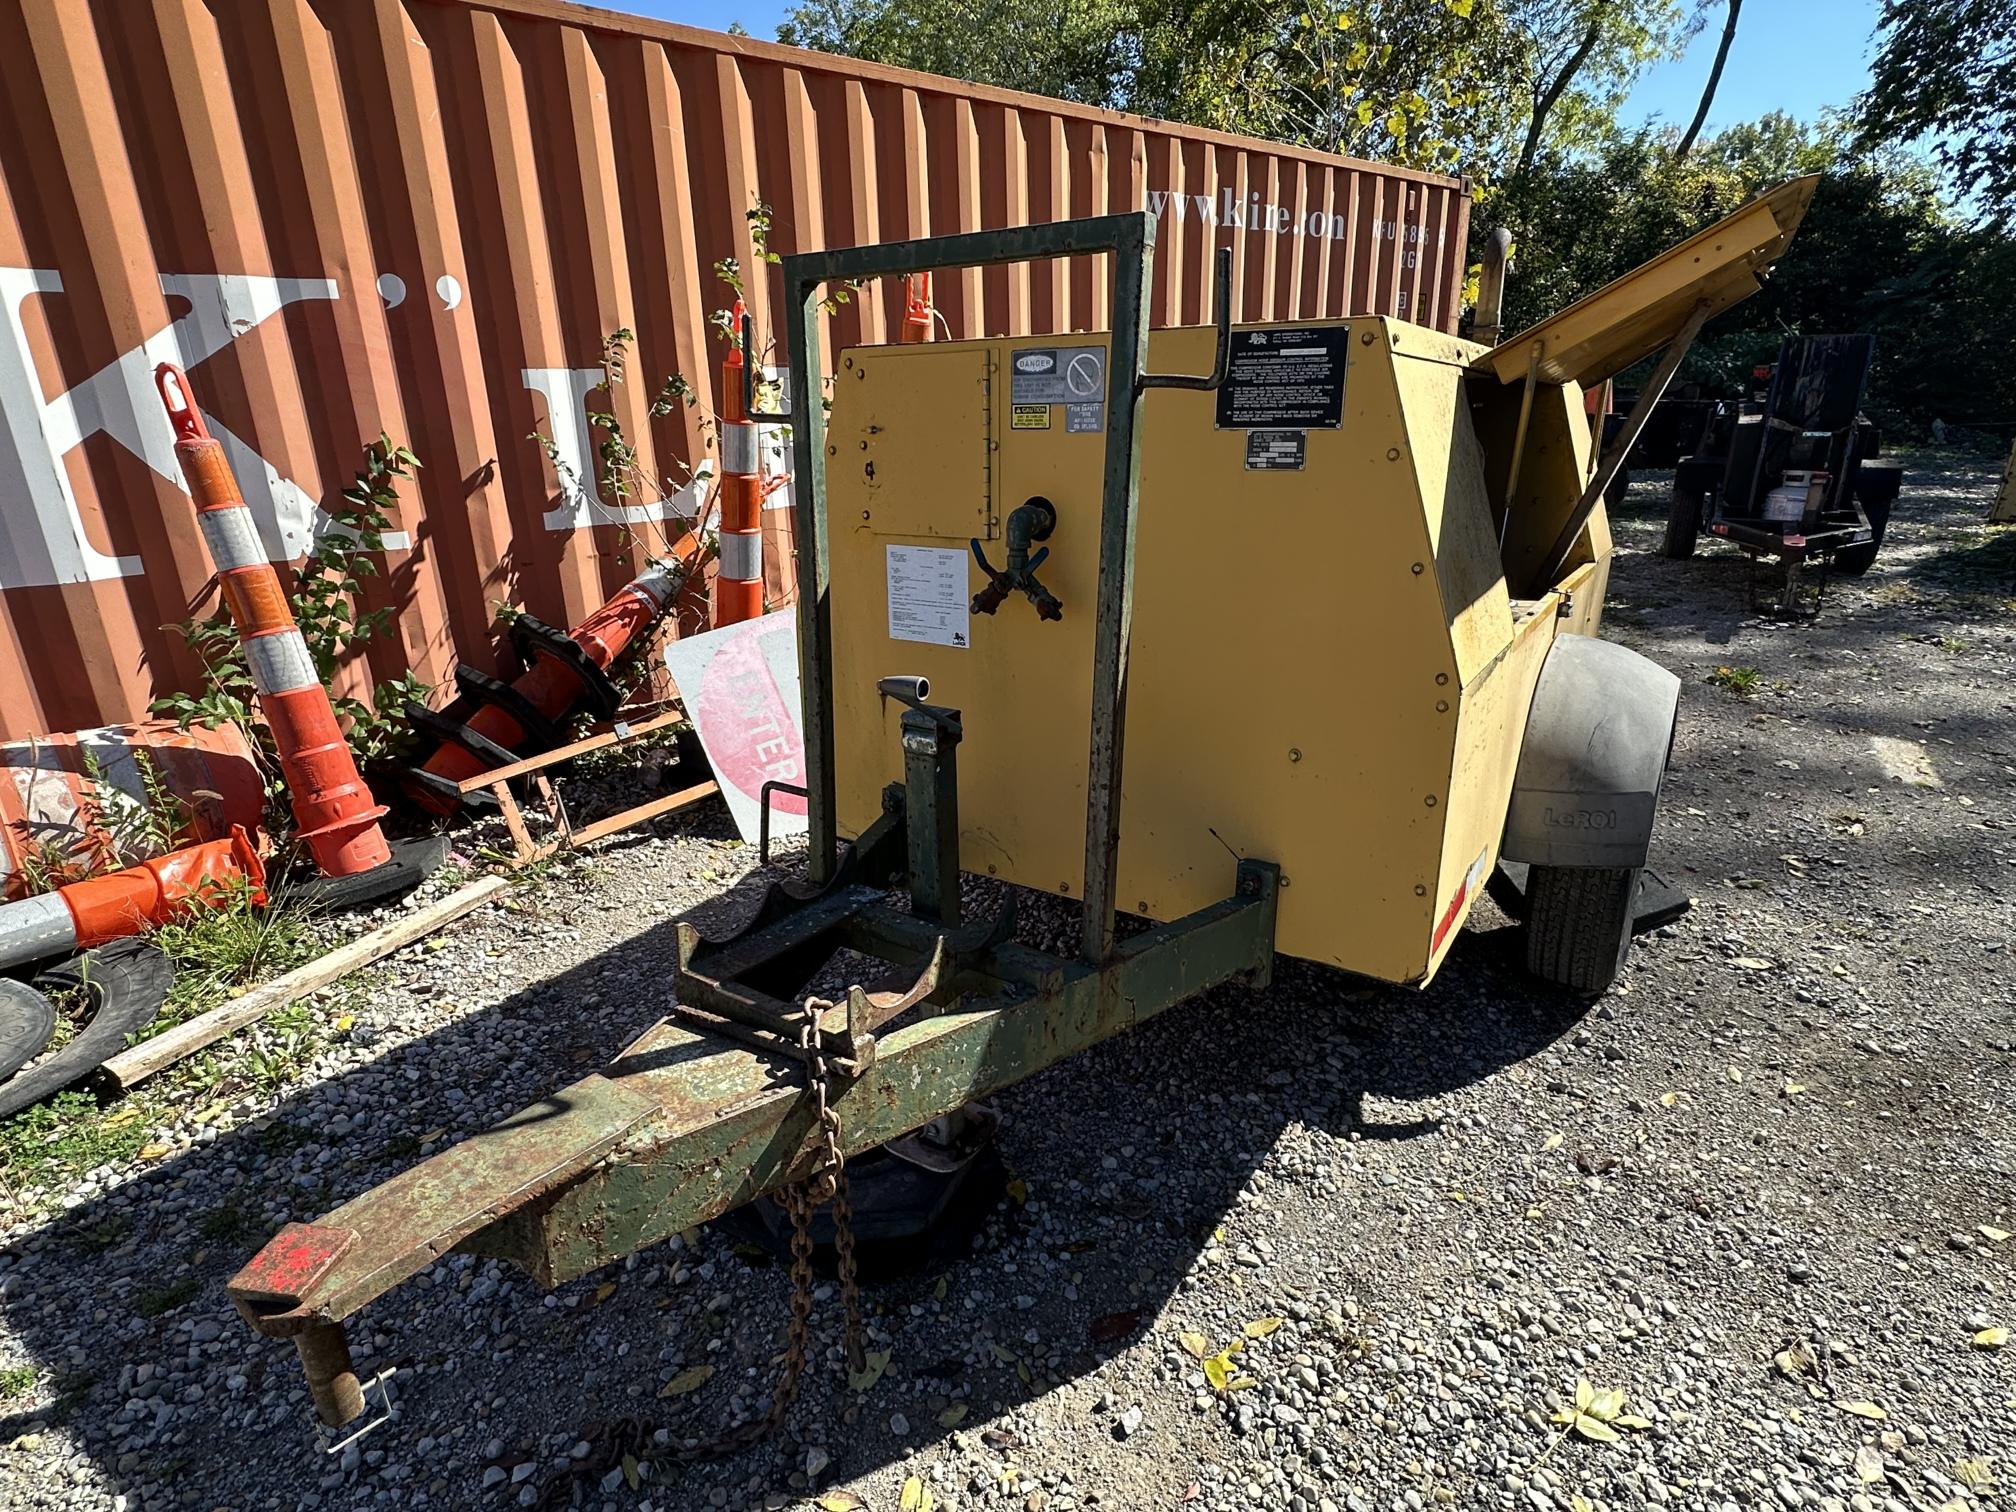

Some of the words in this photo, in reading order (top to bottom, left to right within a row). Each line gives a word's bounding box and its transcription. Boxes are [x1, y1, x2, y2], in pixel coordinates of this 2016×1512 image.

[1019, 359, 1051, 369] DANGER
[1021, 406, 1047, 414] CAUTION
[726, 669, 799, 781] ENTER
